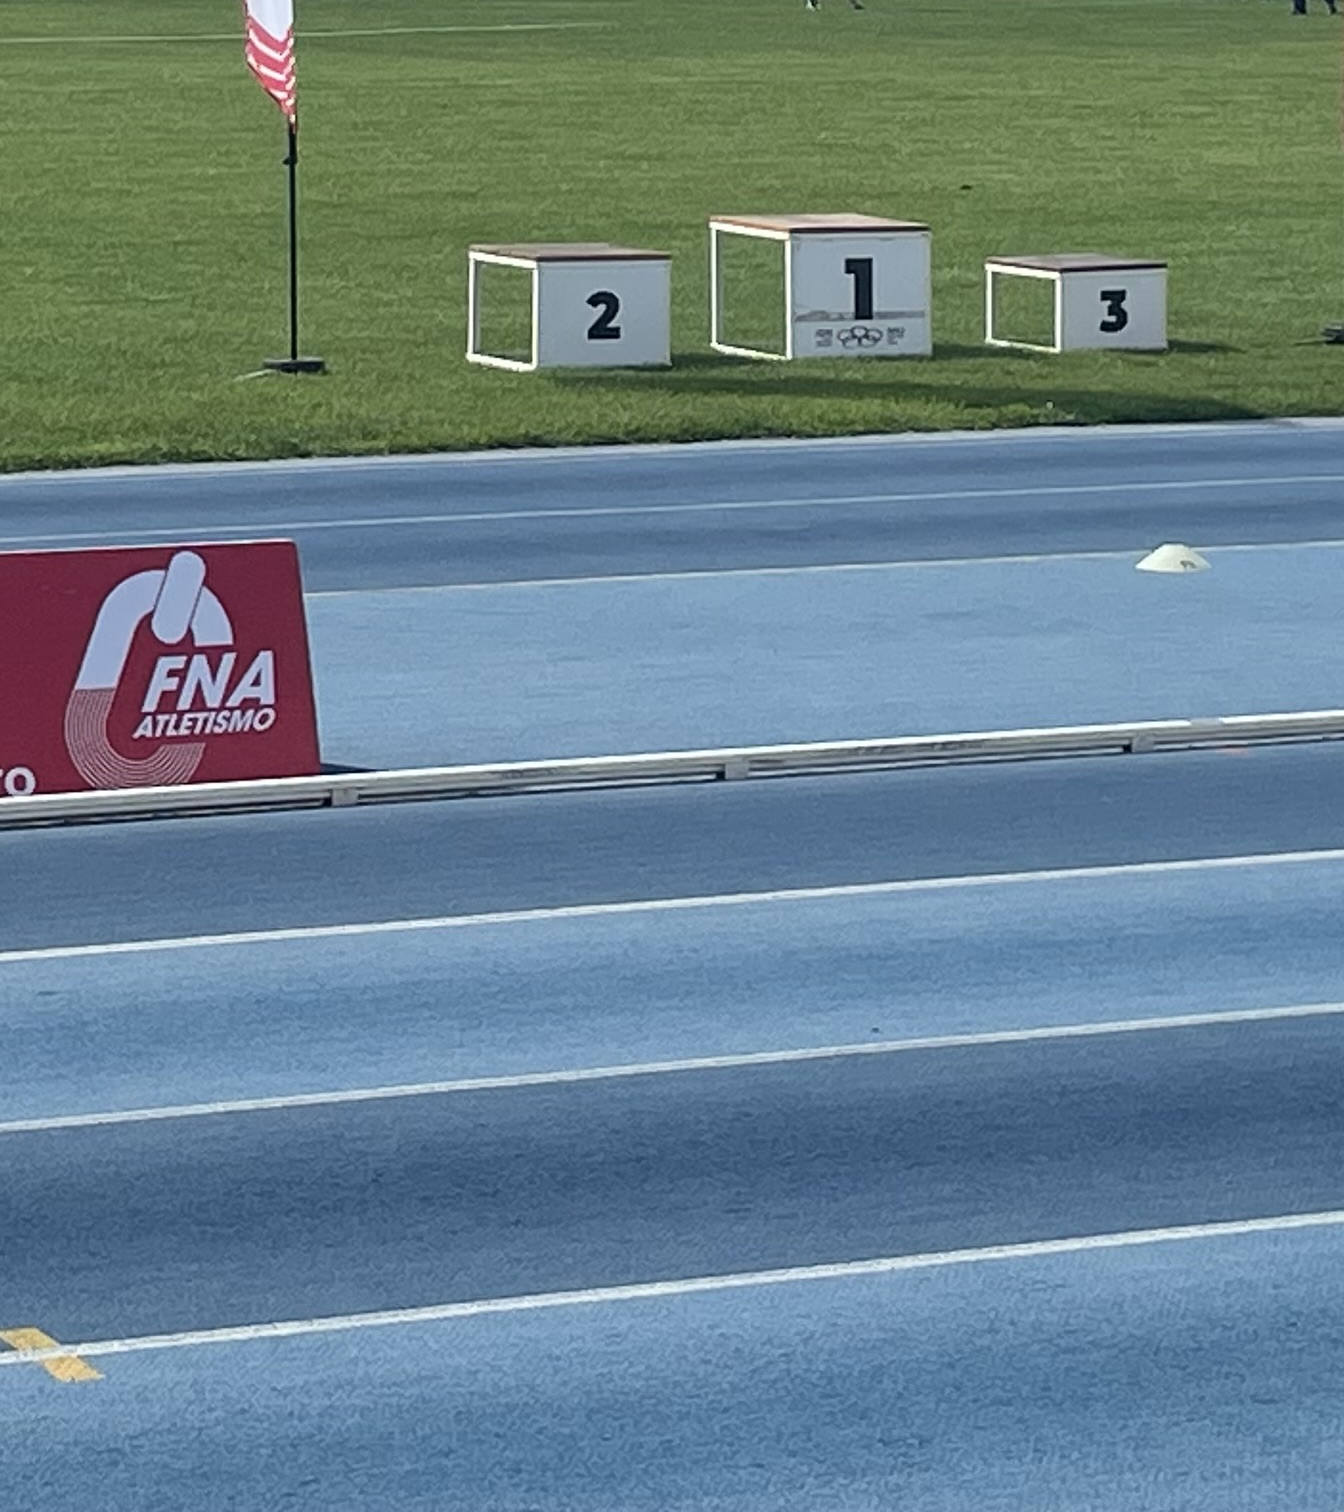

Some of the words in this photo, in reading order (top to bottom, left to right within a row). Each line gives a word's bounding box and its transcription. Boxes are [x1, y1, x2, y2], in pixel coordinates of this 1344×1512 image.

[844, 257, 874, 320] 1
[1099, 288, 1128, 333] 3
[585, 290, 622, 340] 2
[140, 649, 276, 713] FNA
[132, 706, 277, 740] ATLETISMO
